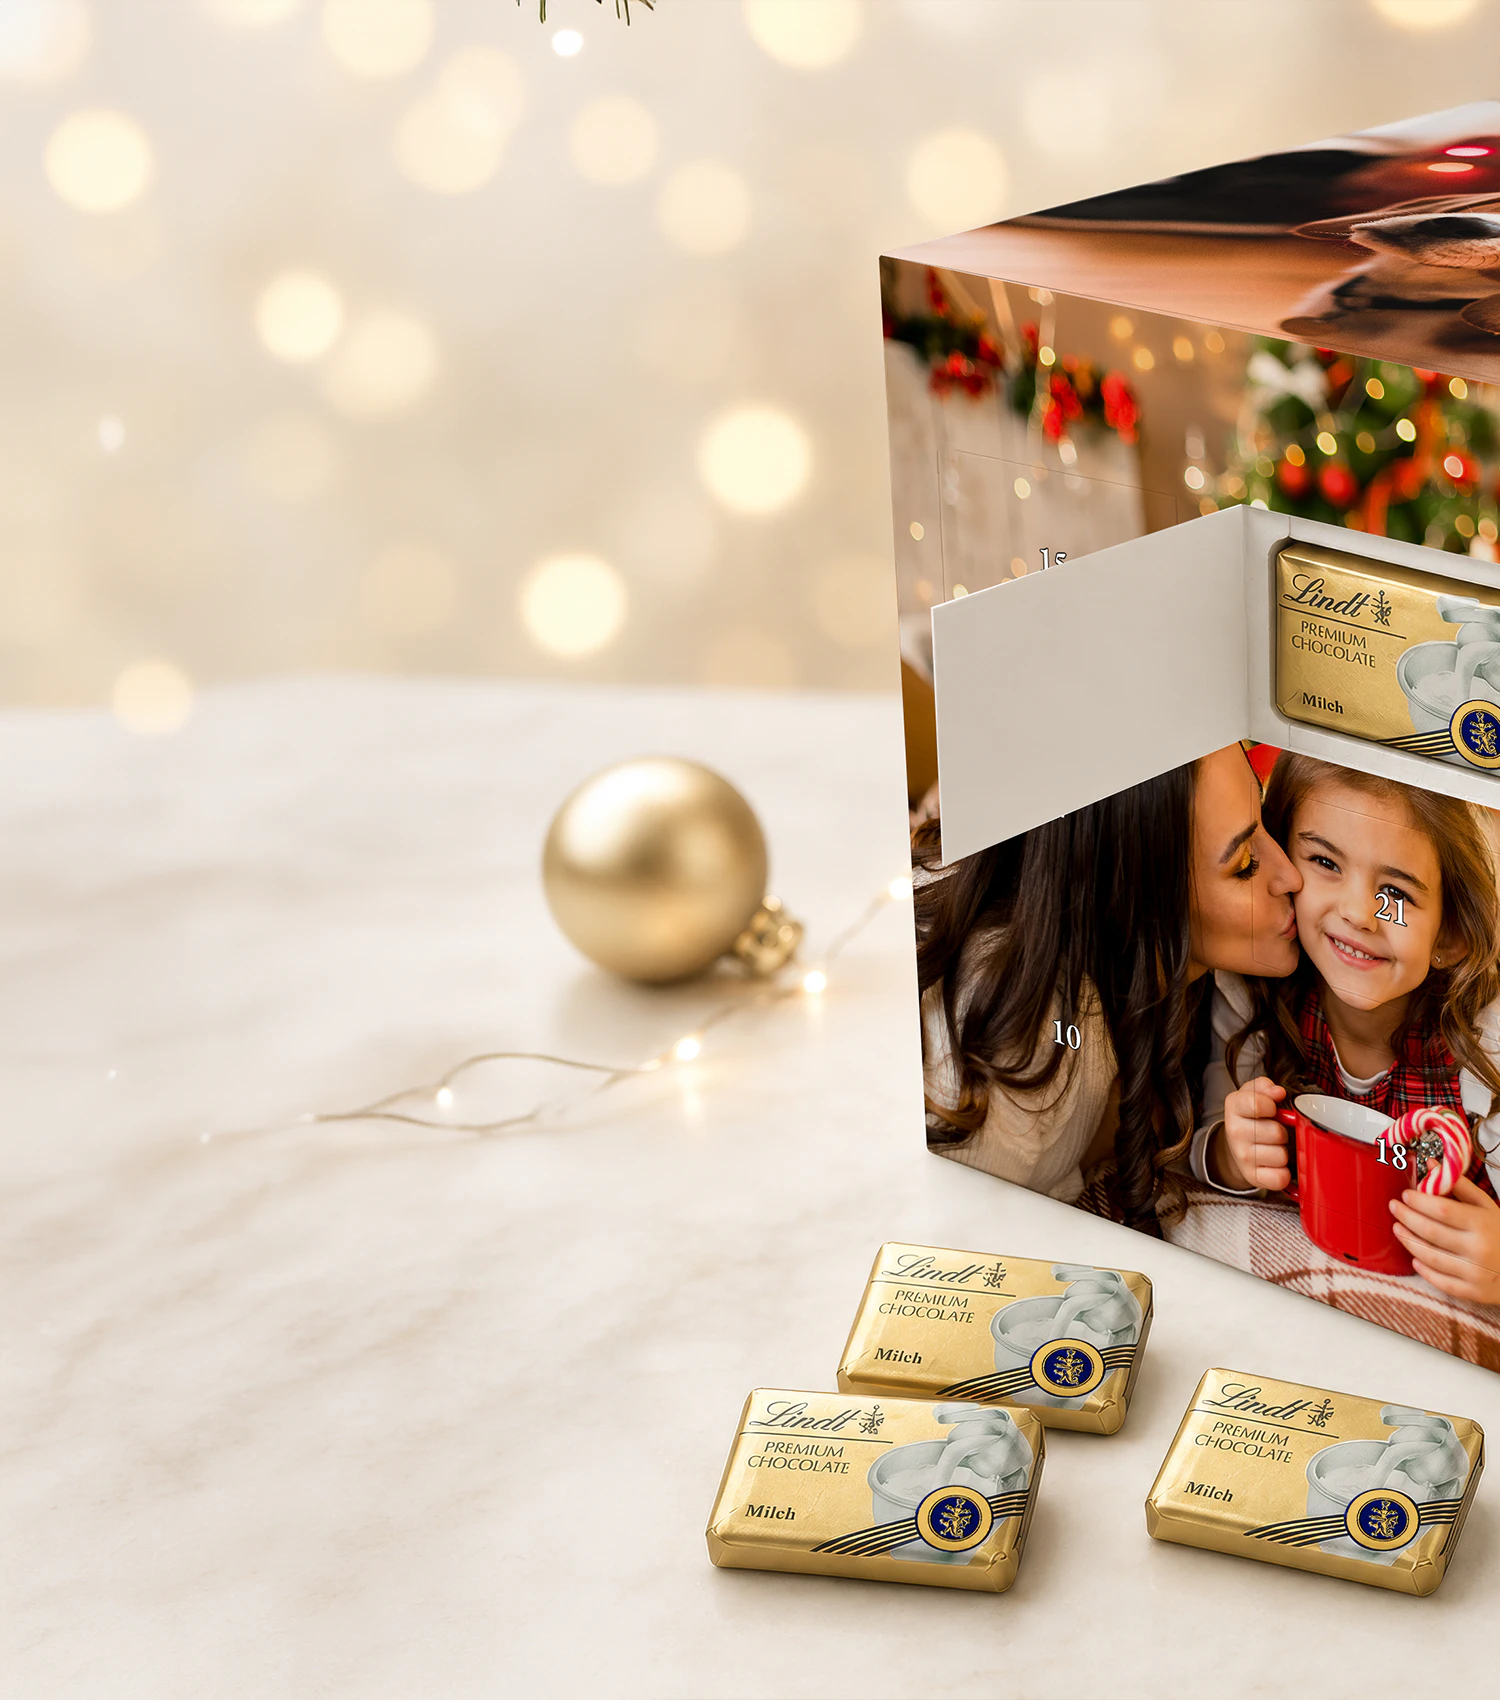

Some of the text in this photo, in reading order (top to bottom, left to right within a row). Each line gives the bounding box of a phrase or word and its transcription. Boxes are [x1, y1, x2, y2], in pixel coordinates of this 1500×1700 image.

[1282, 573, 1371, 618] Lindt
[1301, 620, 1367, 649] PREMIUM
[1291, 634, 1376, 668] CHOCOLATE
[1302, 692, 1344, 715] Milch
[1374, 892, 1408, 928] 21
[1053, 1019, 1082, 1051] 10
[1376, 1137, 1408, 1171] 18
[881, 1253, 985, 1284] Lindt
[894, 1289, 969, 1308] PREMIUM
[878, 1303, 975, 1324] CHOCOLATE
[874, 1347, 922, 1365] Milch
[748, 1401, 862, 1432] Lindt
[1202, 1383, 1314, 1421] Lindt
[1194, 1433, 1294, 1464] CHOCOLATE
[1212, 1421, 1290, 1447] PREMIUM
[764, 1441, 845, 1458] PREMIUM
[747, 1455, 851, 1474] CHOCOLATE
[1184, 1481, 1234, 1503] Milch
[744, 1504, 796, 1520] Milch
